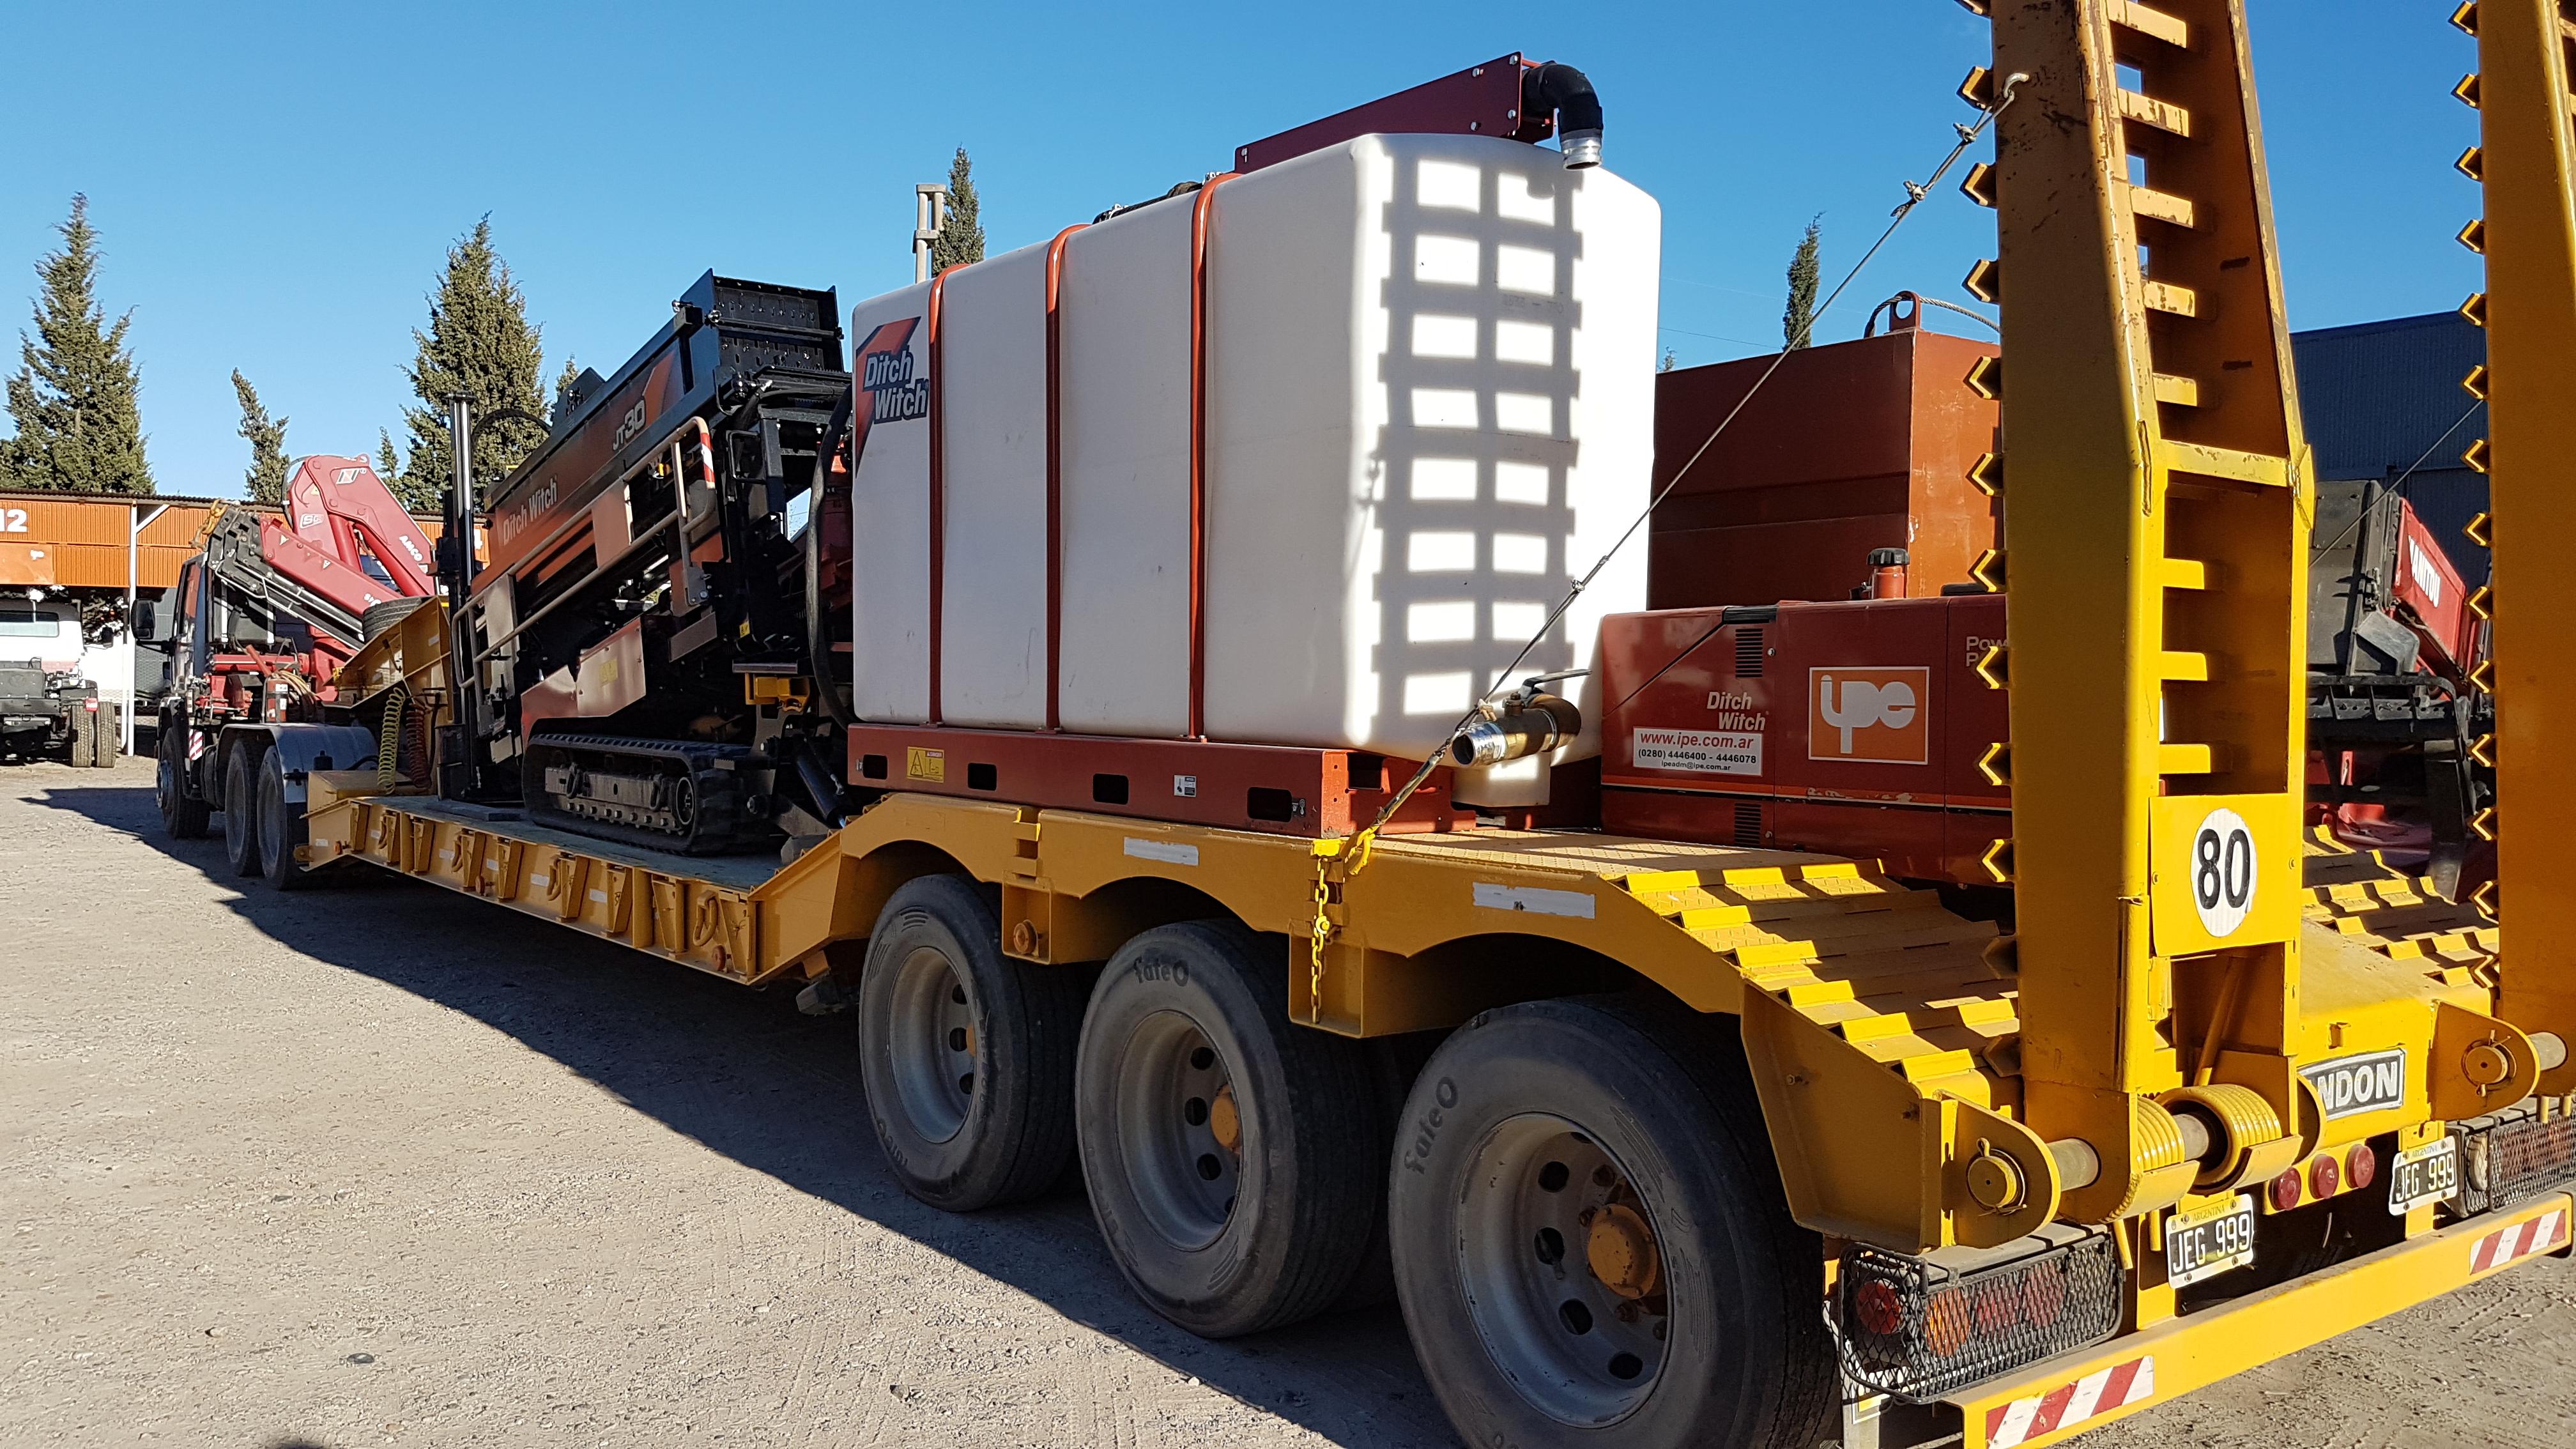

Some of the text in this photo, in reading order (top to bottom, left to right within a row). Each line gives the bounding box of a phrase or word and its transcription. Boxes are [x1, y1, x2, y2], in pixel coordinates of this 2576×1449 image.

[864, 350, 912, 388] Ditch
[875, 383, 926, 420] Witch
[613, 400, 645, 450] JT30
[503, 478, 557, 546] Ditch Witch
[399, 535, 423, 562] AMCO
[2408, 535, 2441, 608] ANITOU
[1966, 636, 2008, 651] Pow
[1706, 691, 1752, 710] Ditch
[1821, 675, 1915, 753] ipe
[1719, 712, 1765, 730] Witch
[1638, 749, 1666, 760] (0280)
[1667, 751, 1706, 761] 4446400
[1716, 754, 1756, 763] 4446078
[1640, 732, 1754, 749] www.ipe.com.ar
[1661, 760, 1731, 770] ipeadm@ipe.com.ar
[2198, 829, 2250, 909] 80
[2309, 1061, 2398, 1110] NDON
[2396, 1153, 2455, 1202] JEG 999
[2193, 1204, 2225, 1222] ARGENTINA
[2173, 1213, 2250, 1273] JEG 999
